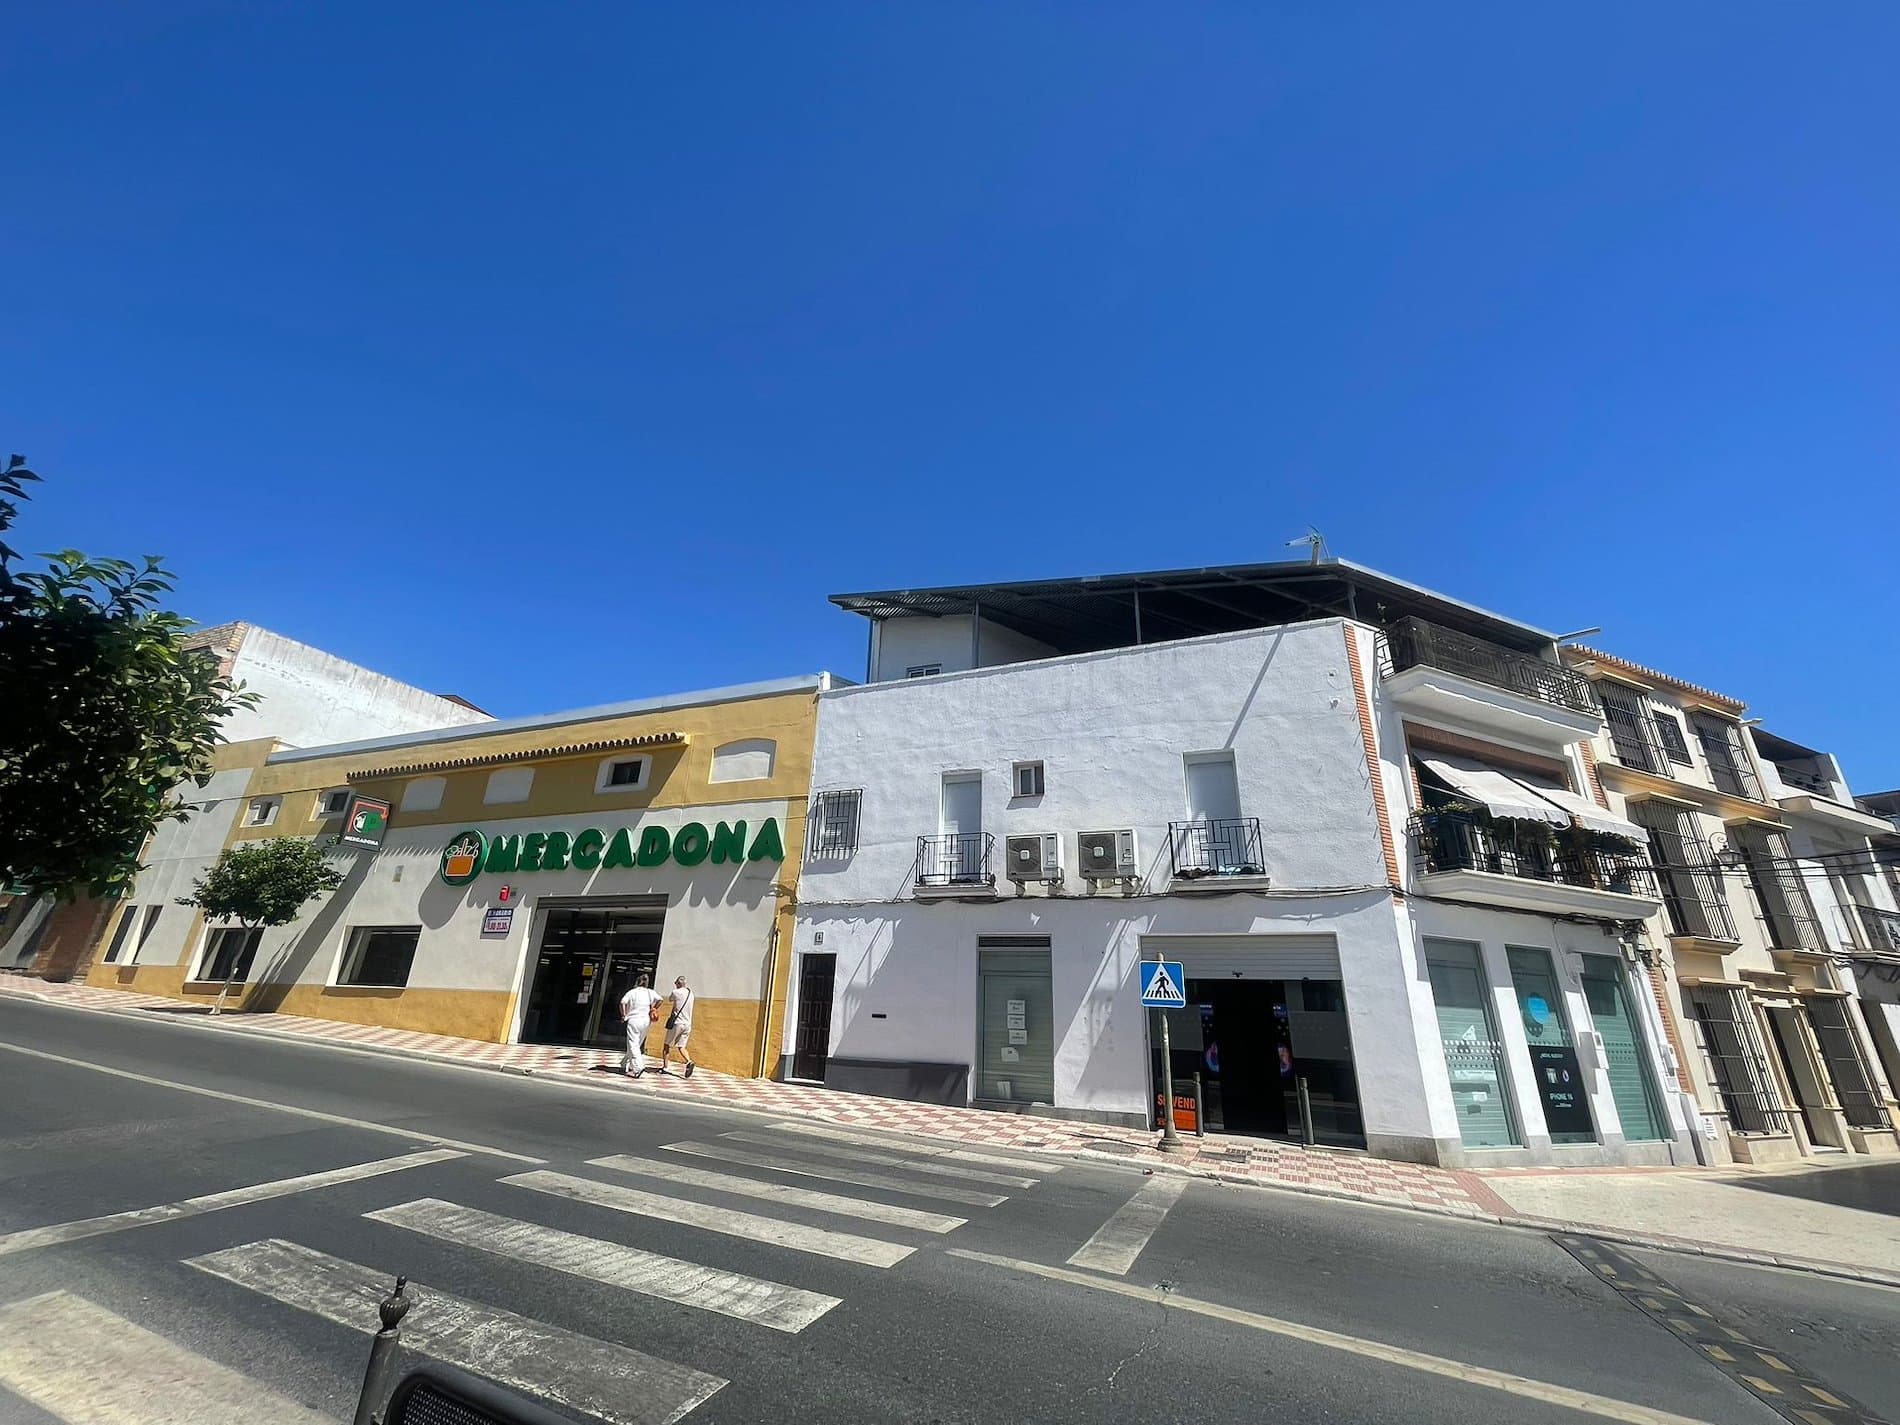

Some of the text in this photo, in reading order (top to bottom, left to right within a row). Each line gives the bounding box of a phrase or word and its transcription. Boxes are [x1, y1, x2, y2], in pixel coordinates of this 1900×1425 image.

[343, 835, 379, 846] MERCADONA
[484, 817, 785, 873] MERCADONA
[1172, 1095, 1196, 1110] VEND
